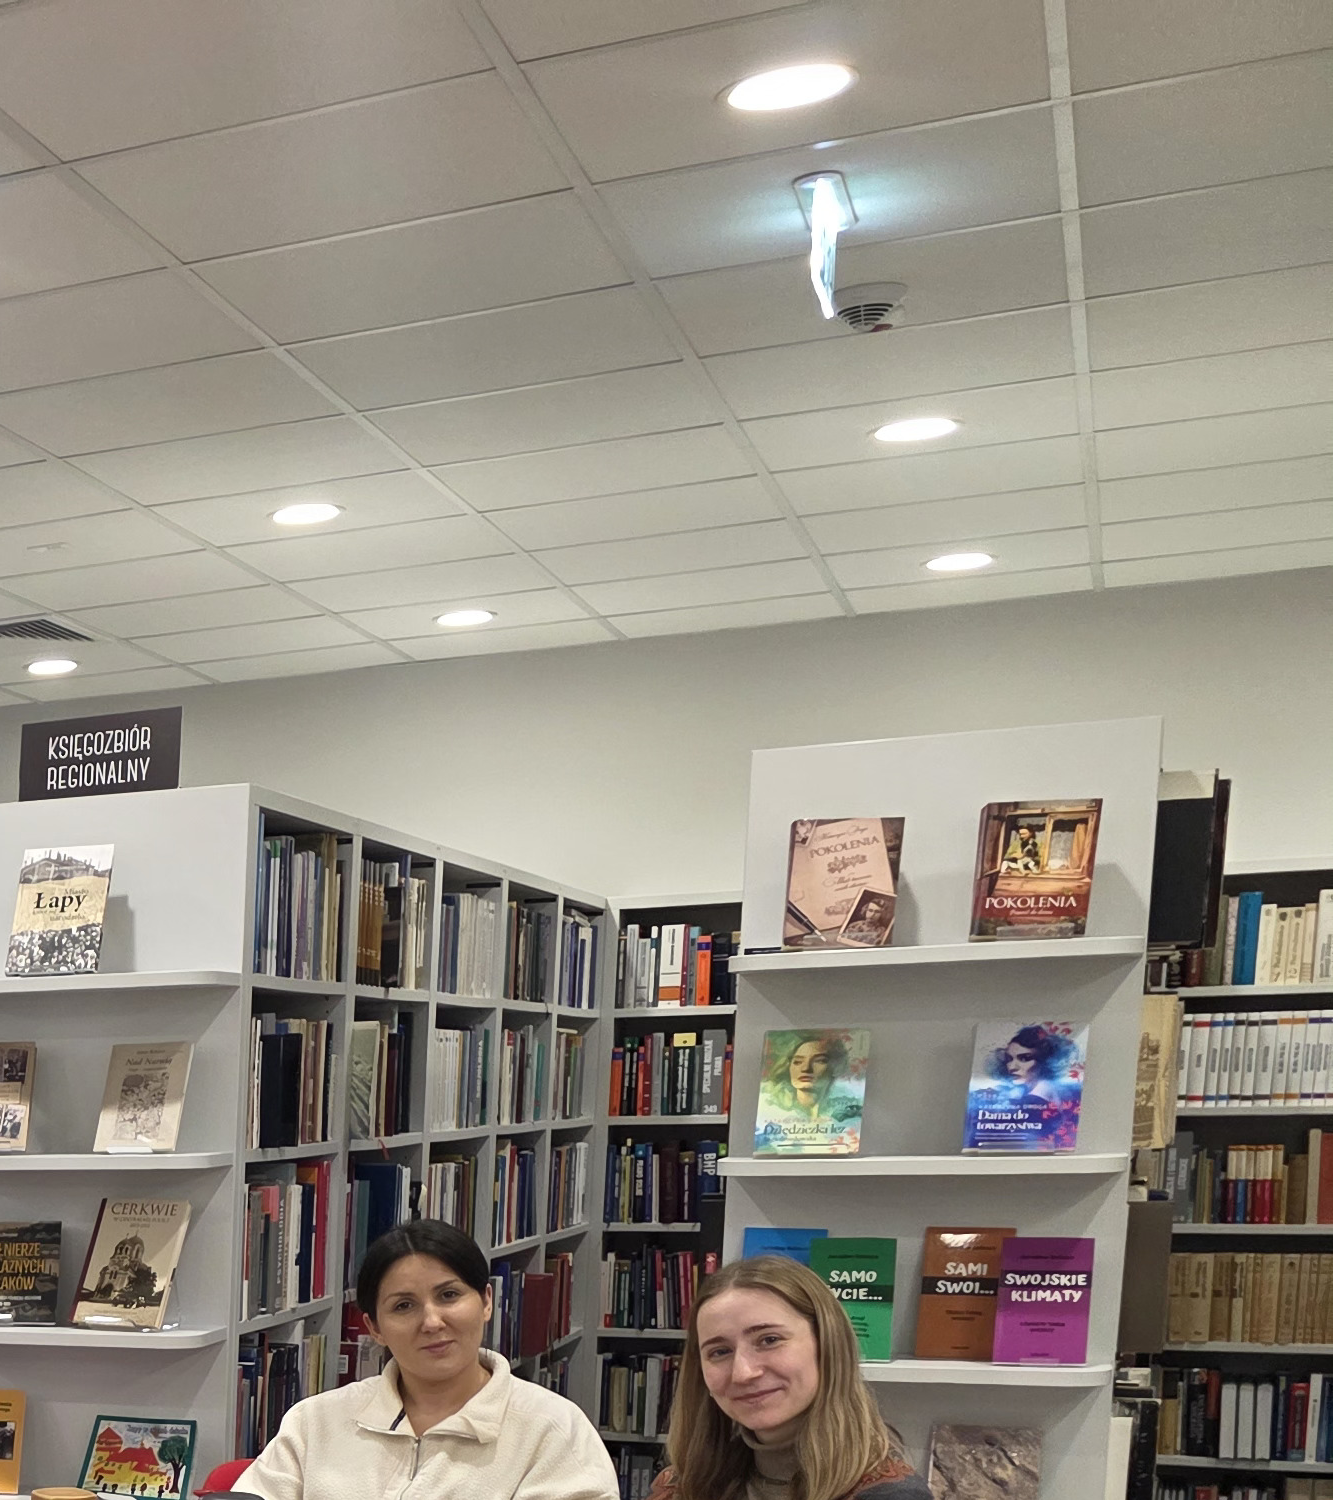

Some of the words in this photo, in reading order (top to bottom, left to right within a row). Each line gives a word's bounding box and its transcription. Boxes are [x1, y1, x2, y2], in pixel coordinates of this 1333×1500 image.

[48, 723, 151, 760] KSIĘGOZBIÓR
[46, 757, 151, 790] REGIONALNY
[809, 836, 880, 858] POKOLENIA
[34, 892, 87, 913] Łapy
[985, 896, 1077, 909] POKOLENIA
[978, 1109, 1011, 1120] Dama
[703, 1152, 716, 1176] BHP
[111, 1202, 178, 1217] CERKWIE
[944, 1261, 988, 1276] SAMI
[829, 1270, 877, 1283] SAMO
[1004, 1273, 1087, 1287] SWOJSKIE
[828, 1285, 882, 1300] YCIE...
[935, 1279, 994, 1294] SWOI...
[1011, 1289, 1082, 1303] KLIMATY
